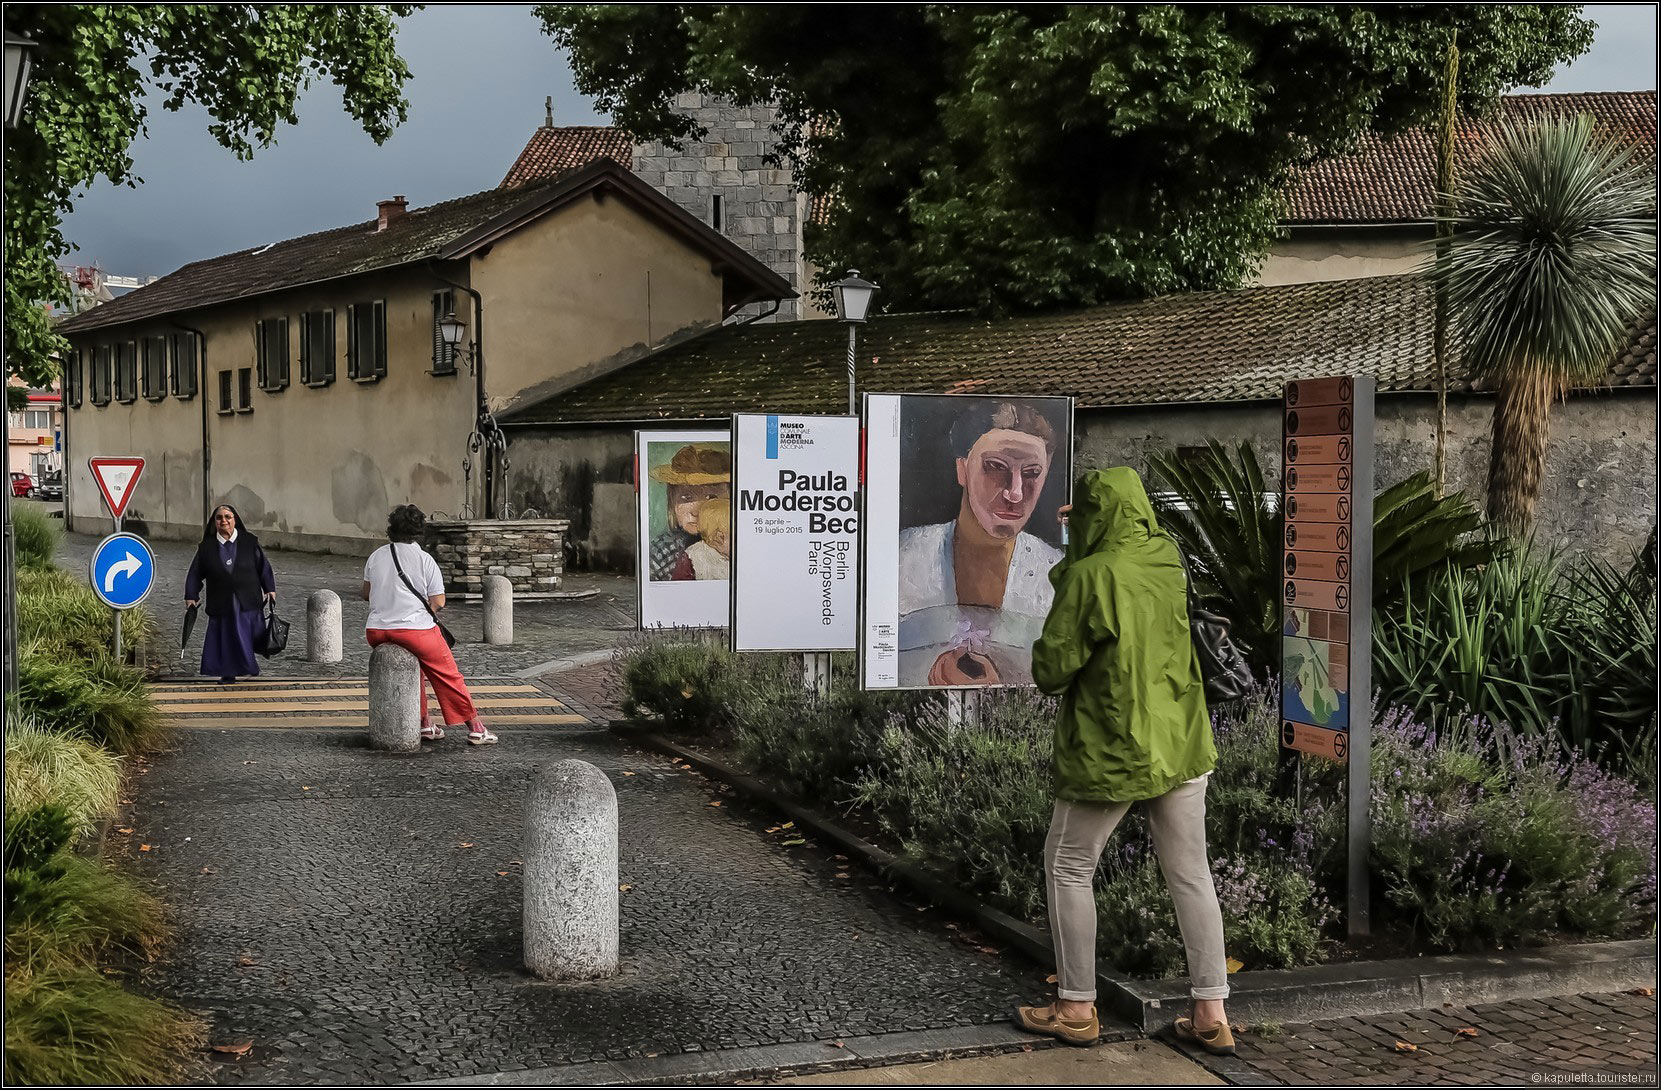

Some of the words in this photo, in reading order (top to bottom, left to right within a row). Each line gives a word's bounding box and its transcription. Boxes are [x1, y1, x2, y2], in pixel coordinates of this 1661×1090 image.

[779, 470, 847, 491] Paula
[765, 518, 784, 527] aprile
[765, 527, 784, 536] luglio
[809, 541, 821, 575] Paris
[837, 542, 849, 580] Berlin
[819, 541, 835, 626] Worpswede
